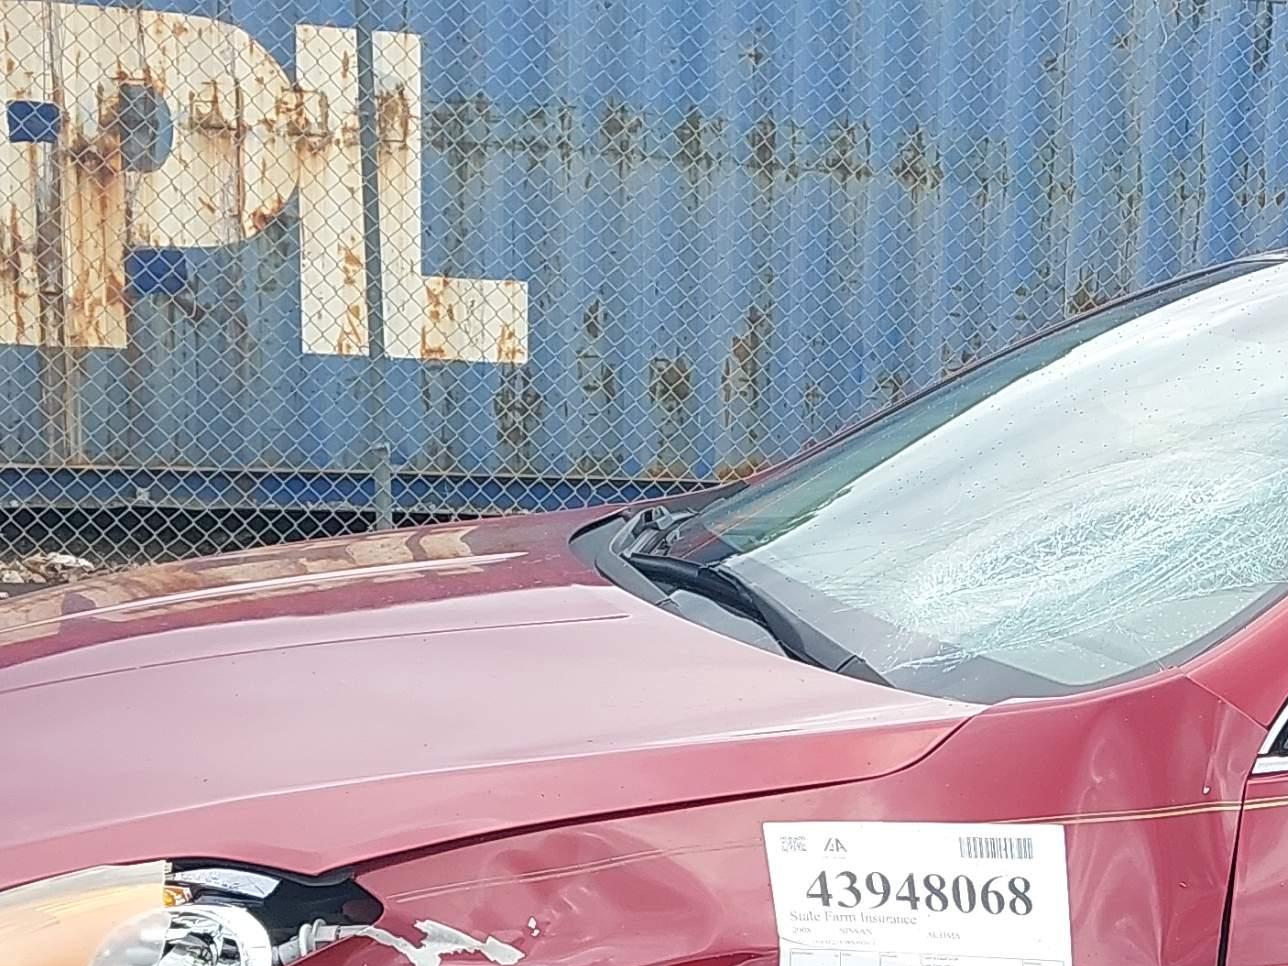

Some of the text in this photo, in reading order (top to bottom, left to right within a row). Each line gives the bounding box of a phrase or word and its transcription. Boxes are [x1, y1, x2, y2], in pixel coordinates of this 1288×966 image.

[806, 870, 1033, 916] 43948068
[790, 910, 918, 925] State Farm Insurance
